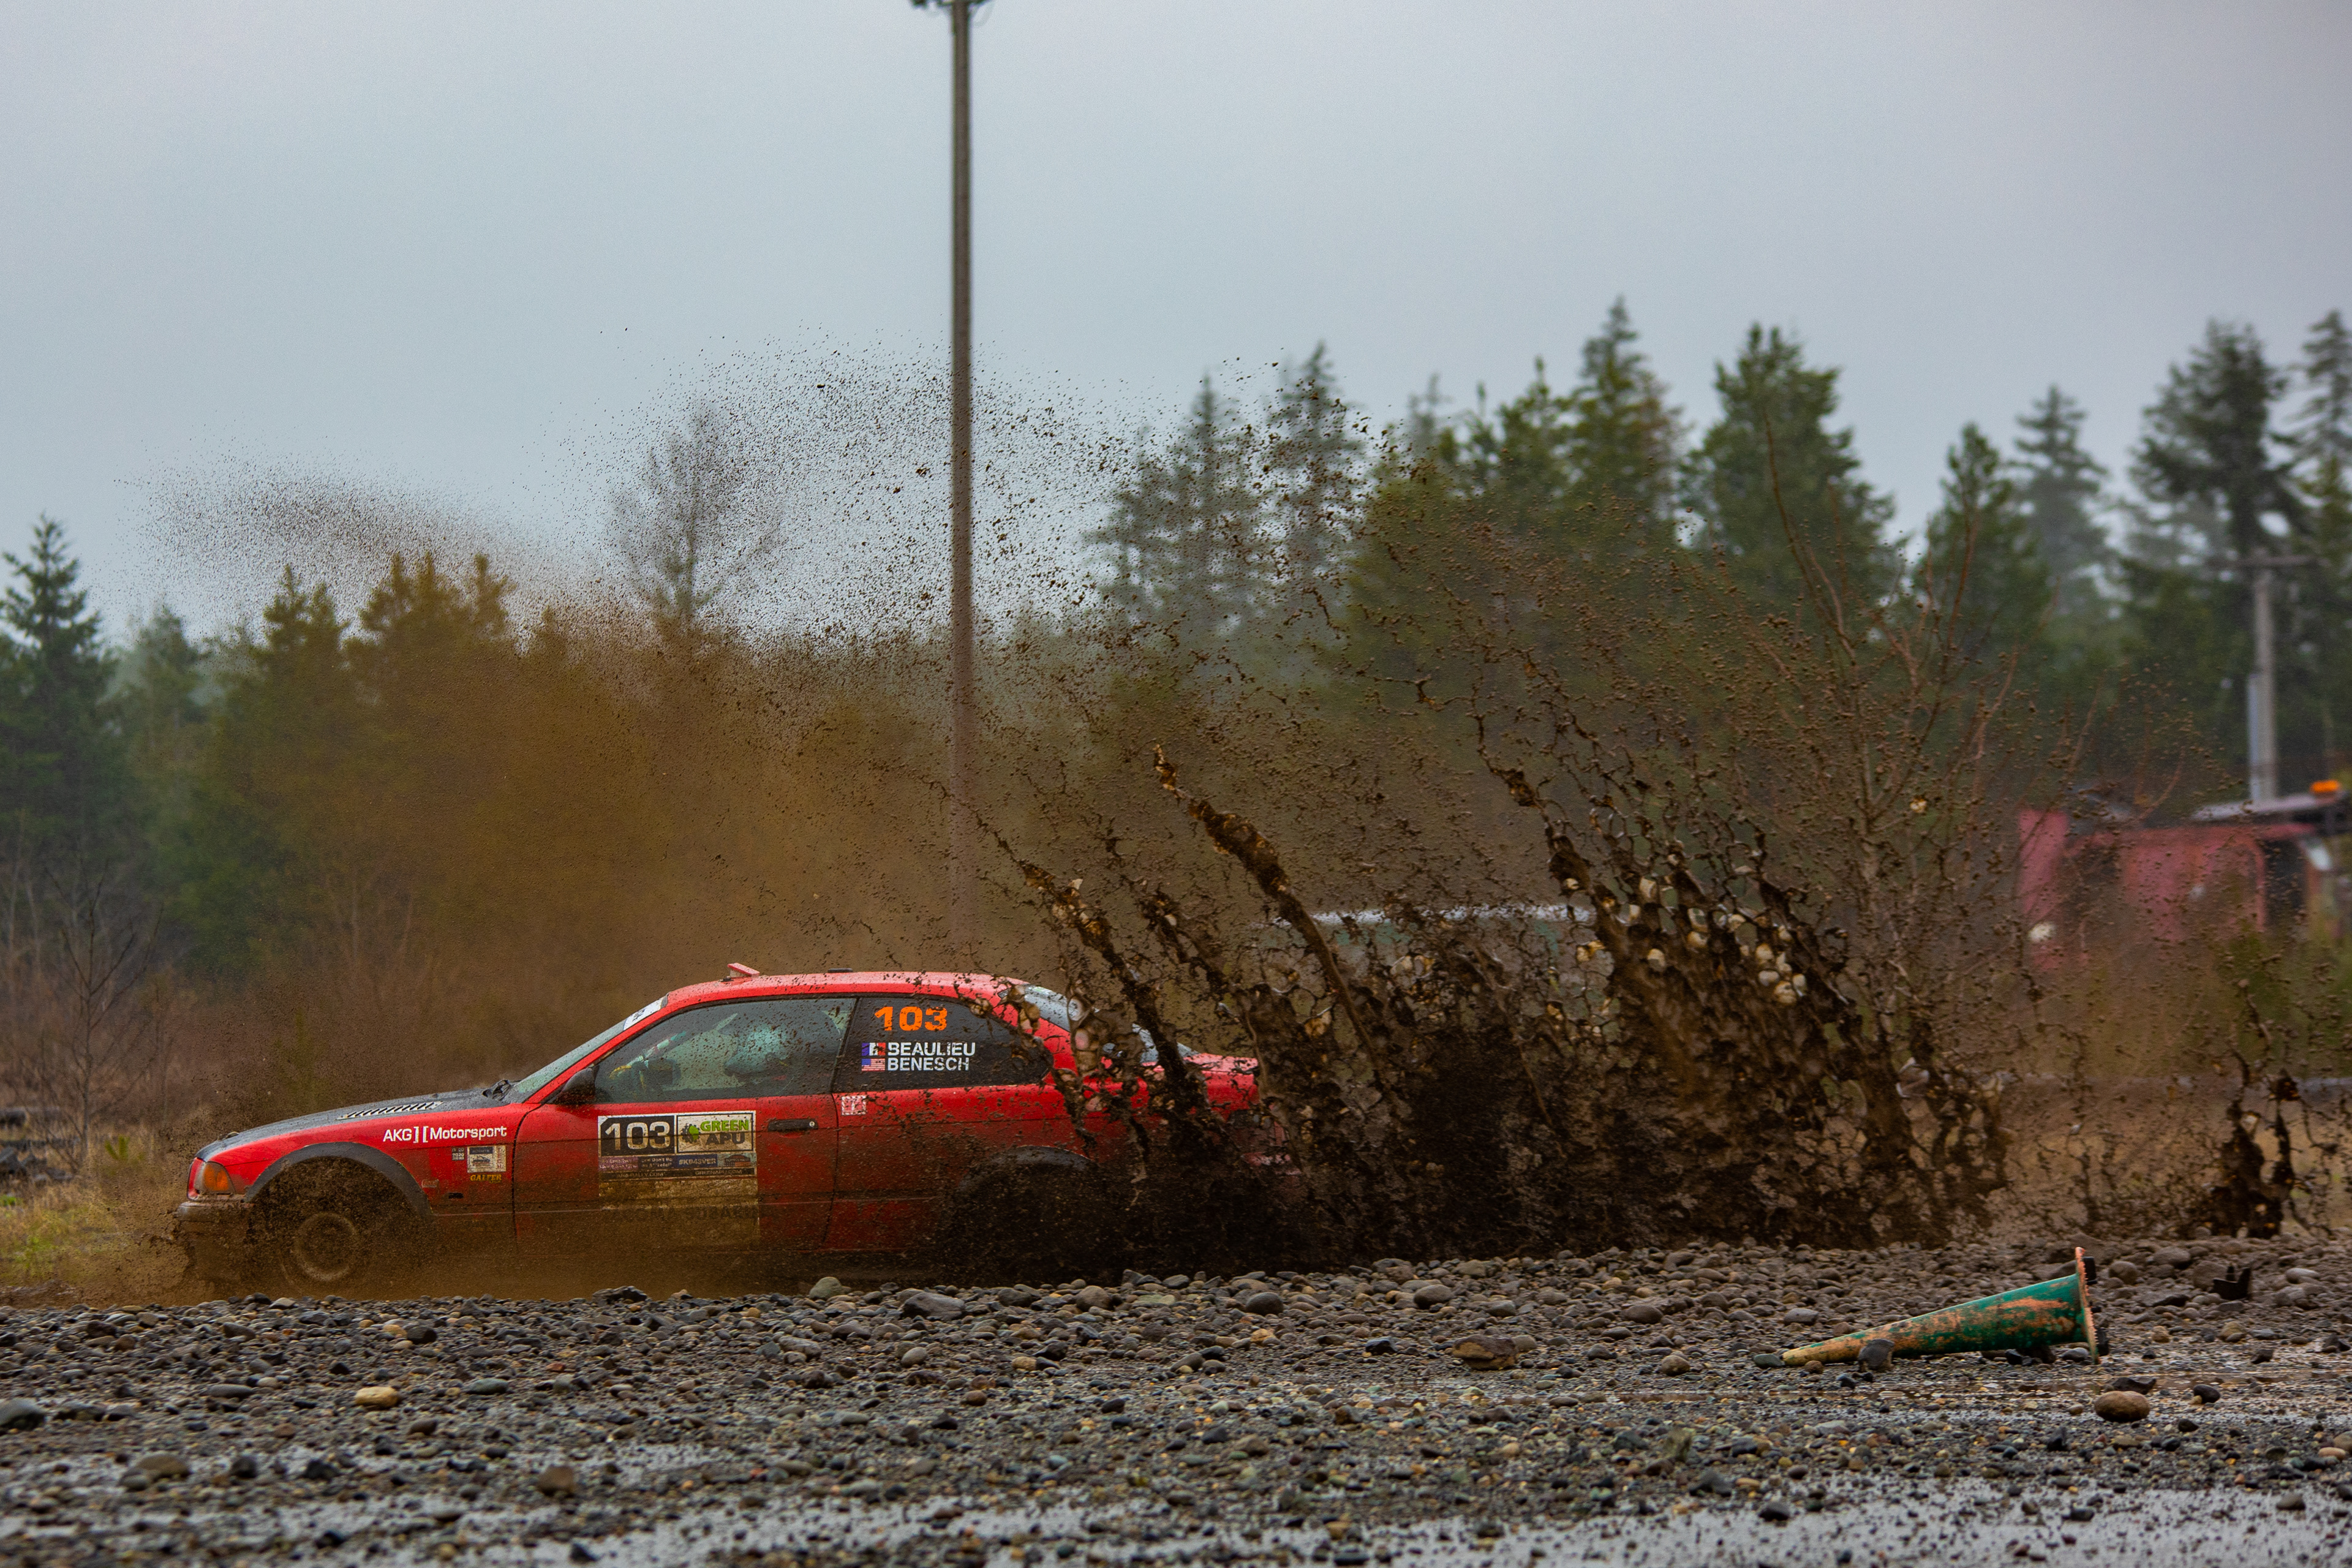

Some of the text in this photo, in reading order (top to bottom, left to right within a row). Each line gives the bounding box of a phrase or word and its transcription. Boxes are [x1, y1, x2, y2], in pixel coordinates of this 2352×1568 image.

[875, 1006, 948, 1031] 103
[888, 1042, 976, 1057] BEAULIEU
[888, 1057, 969, 1071] BENESCH
[701, 1119, 749, 1132] GREEN
[605, 1121, 670, 1150] 103
[705, 1133, 745, 1145] APU
